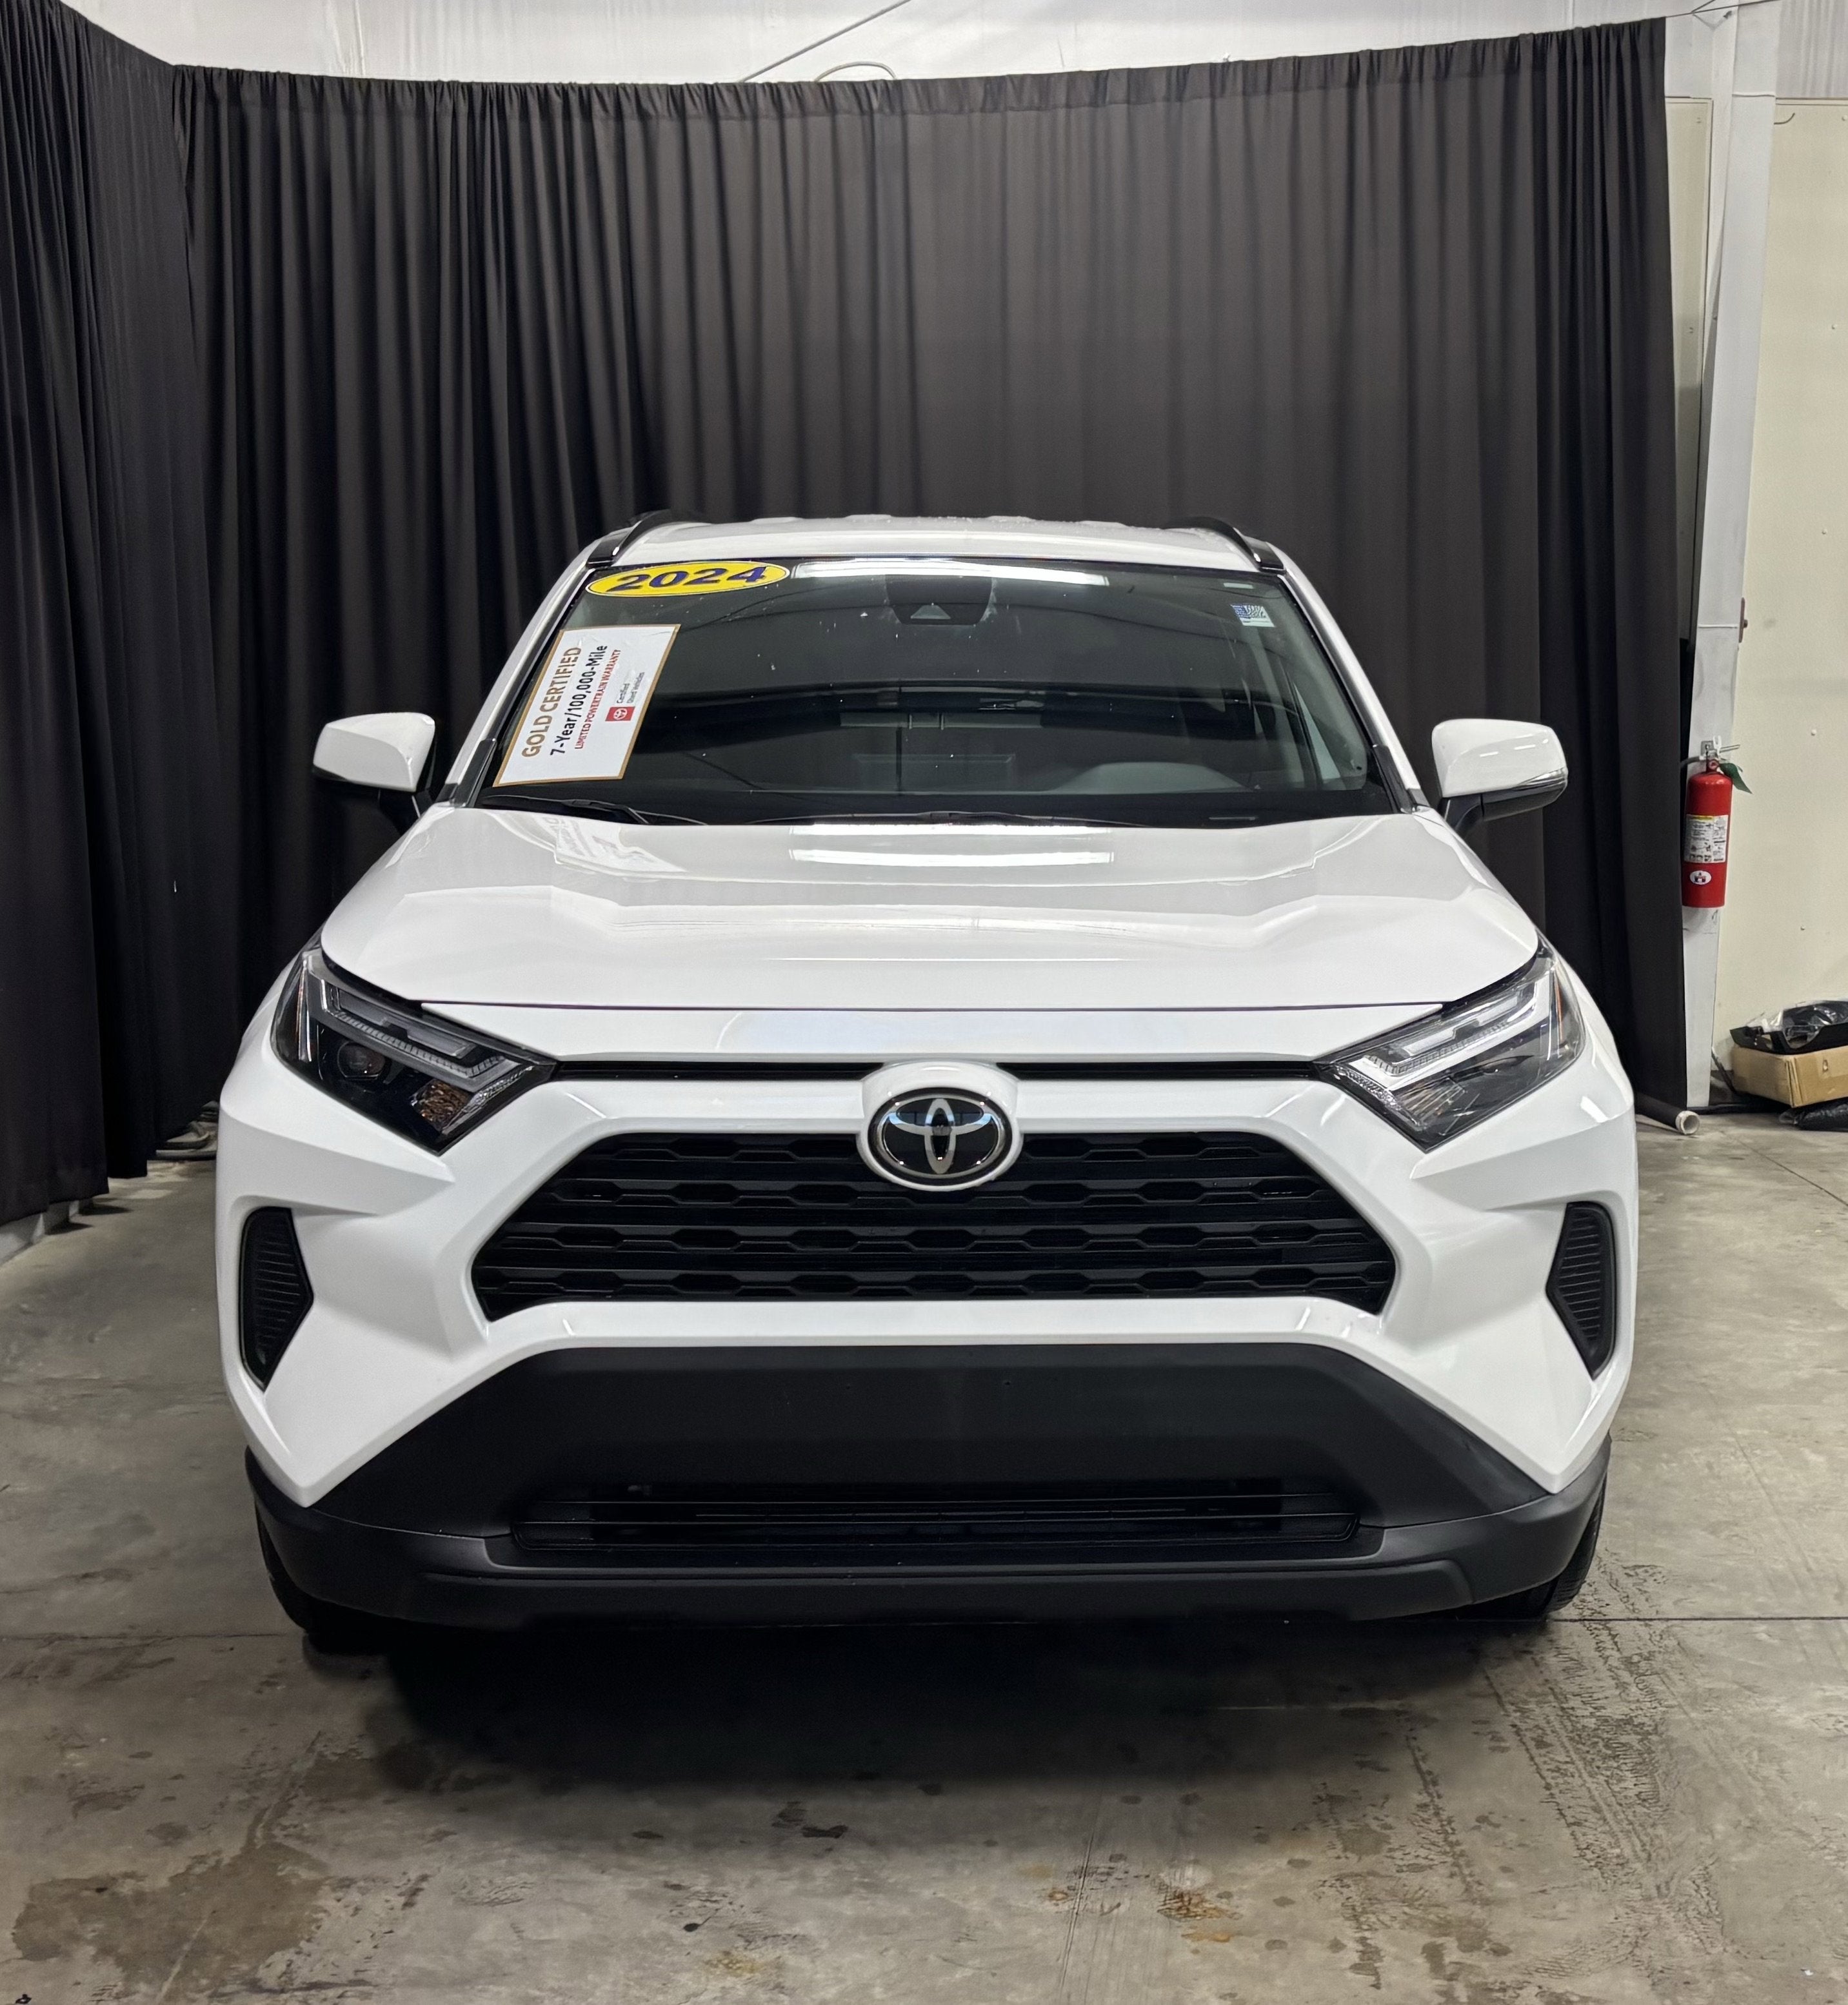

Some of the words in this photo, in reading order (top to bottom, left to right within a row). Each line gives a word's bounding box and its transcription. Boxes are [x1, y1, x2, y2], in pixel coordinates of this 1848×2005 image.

[606, 566, 767, 592] 2024
[521, 715, 553, 758] GOLD
[539, 647, 582, 713] CERTIFIED
[550, 646, 608, 756] 7-Year/100,000-Mile
[574, 723, 591, 749] LIMITED
[584, 682, 608, 722] POWERTRAIN
[601, 649, 621, 681] WARRANTY
